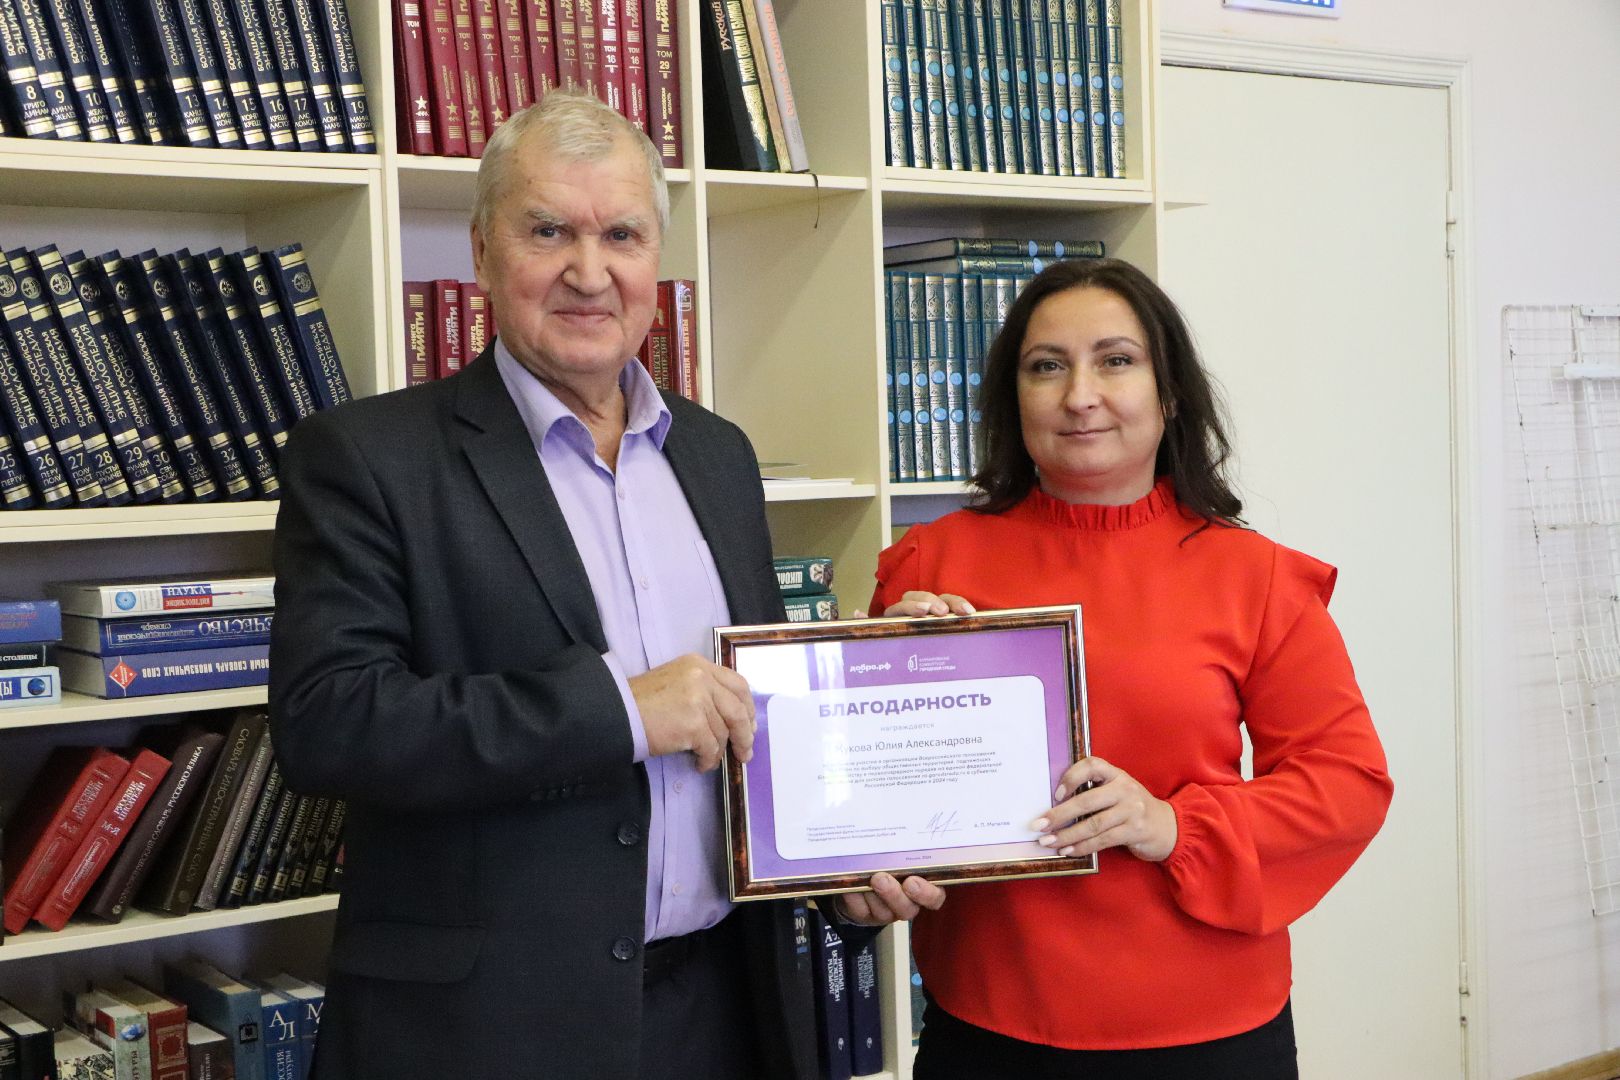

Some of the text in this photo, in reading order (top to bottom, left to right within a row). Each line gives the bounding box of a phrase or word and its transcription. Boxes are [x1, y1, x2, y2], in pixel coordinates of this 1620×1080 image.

[26, 18, 46, 61] БОЛЬШАЯ
[61, 22, 80, 64] БОЛЬШАЯ
[411, 30, 418, 39] 1
[440, 37, 448, 46] 2
[91, 24, 110, 66] БОЛЬШАЯ
[162, 24, 180, 66] БОЛЬШАЯ
[191, 27, 209, 69] БОЛЬШАЯ
[220, 29, 237, 71] БОЛЬШАЯ
[248, 31, 265, 72] БОЛЬШАЯ
[274, 30, 290, 71] БОЛЬШАЯ
[304, 33, 321, 74] БОЛЬШАЯ
[334, 33, 349, 73] БОЛЬШАЯ
[462, 41, 471, 51] 3
[486, 42, 494, 51] 4
[513, 44, 521, 54] 5
[541, 45, 548, 54] 7
[565, 48, 577, 57] 13
[603, 45, 617, 53] ТОМ
[628, 46, 641, 54] ТОМ
[656, 49, 673, 58] ТОМ
[584, 52, 595, 61] 13
[606, 54, 617, 64] 16
[631, 55, 641, 65] 16
[659, 60, 671, 70] 29
[25, 85, 37, 100] 8
[55, 89, 65, 104] 9
[85, 91, 103, 108] 10
[184, 94, 201, 110] 13
[214, 96, 229, 111] 14
[241, 97, 257, 112] 15
[269, 100, 285, 113] 16
[294, 98, 308, 111] 17
[350, 100, 366, 114] 19
[415, 311, 426, 362] ПАМЯТИ
[449, 306, 460, 355] ПАМЯТИ
[470, 325, 478, 352] КНИГА
[475, 313, 485, 357] АМЯТИ
[682, 318, 690, 348] БИТВЫ
[270, 326, 295, 381] РОССИЙСКАЯ
[308, 322, 332, 377] РОССИЙСКАЯ
[684, 348, 690, 357] И
[15, 330, 60, 429] БОЛЬШАЯ РОССИЙСКАЯ
[24, 326, 71, 426] ЭНЦИКЛОПЕДИЯ
[41, 331, 87, 429] БОЛЬШАЯ РОССИЙСКАЯ
[49, 327, 97, 425] ЭНЦИКЛОПЕДИЯ
[70, 327, 117, 424] БОЛЬШАЯ РОССИЙСКАЯ
[79, 323, 128, 420] ЭНЦИКЛОПЕДИЯ
[135, 332, 180, 428] БОЛЬШАЯ РОССИЙСКАЯ
[172, 330, 215, 425] БОЛЬШАЯ РОССИЙСКАЯ
[237, 329, 278, 423] БОЛЬШАЯ РОССИЙСКАЯ
[100, 334, 145, 428] БОЛЬШАЯ РОССИЙСКАЯ
[6, 388, 28, 429] БОЛЬШАЯ
[227, 385, 248, 424] БОЛЬШАЯ
[0, 453, 17, 471] 25
[36, 453, 55, 471] 26
[68, 452, 84, 470] 27
[95, 450, 113, 468] 28
[125, 446, 143, 464] 29
[152, 450, 170, 468] 30
[220, 447, 237, 464] 32
[40, 467, 59, 480] ПЕРУ
[43, 473, 62, 487] ПОЛУ
[71, 466, 91, 480] ПОЛУ
[166, 585, 208, 597] НАУКА
[141, 665, 162, 679] СЛОВ
[163, 662, 213, 677] ИНОЯЗЫЧНЫХ
[215, 661, 248, 674] СЛОВАРЬ
[849, 661, 892, 674] добро.рф
[819, 693, 992, 718] БЛАГОДАРНОСТЬ
[880, 723, 935, 733] награждается
[875, 740, 903, 752] Юлия
[905, 735, 983, 750] Александровна
[113, 780, 138, 816] РУССКИЕ
[151, 745, 205, 842] СЛОВАРЬ РУССКОГО ЯЗЫКА
[794, 916, 807, 931] 10
[827, 958, 836, 995] ЛАУРЕАТЫ
[831, 949, 841, 1002] НОБЕЛЕВСКОЙ
[837, 957, 846, 991] ПРЕМИИ
[268, 1009, 286, 1029] А
